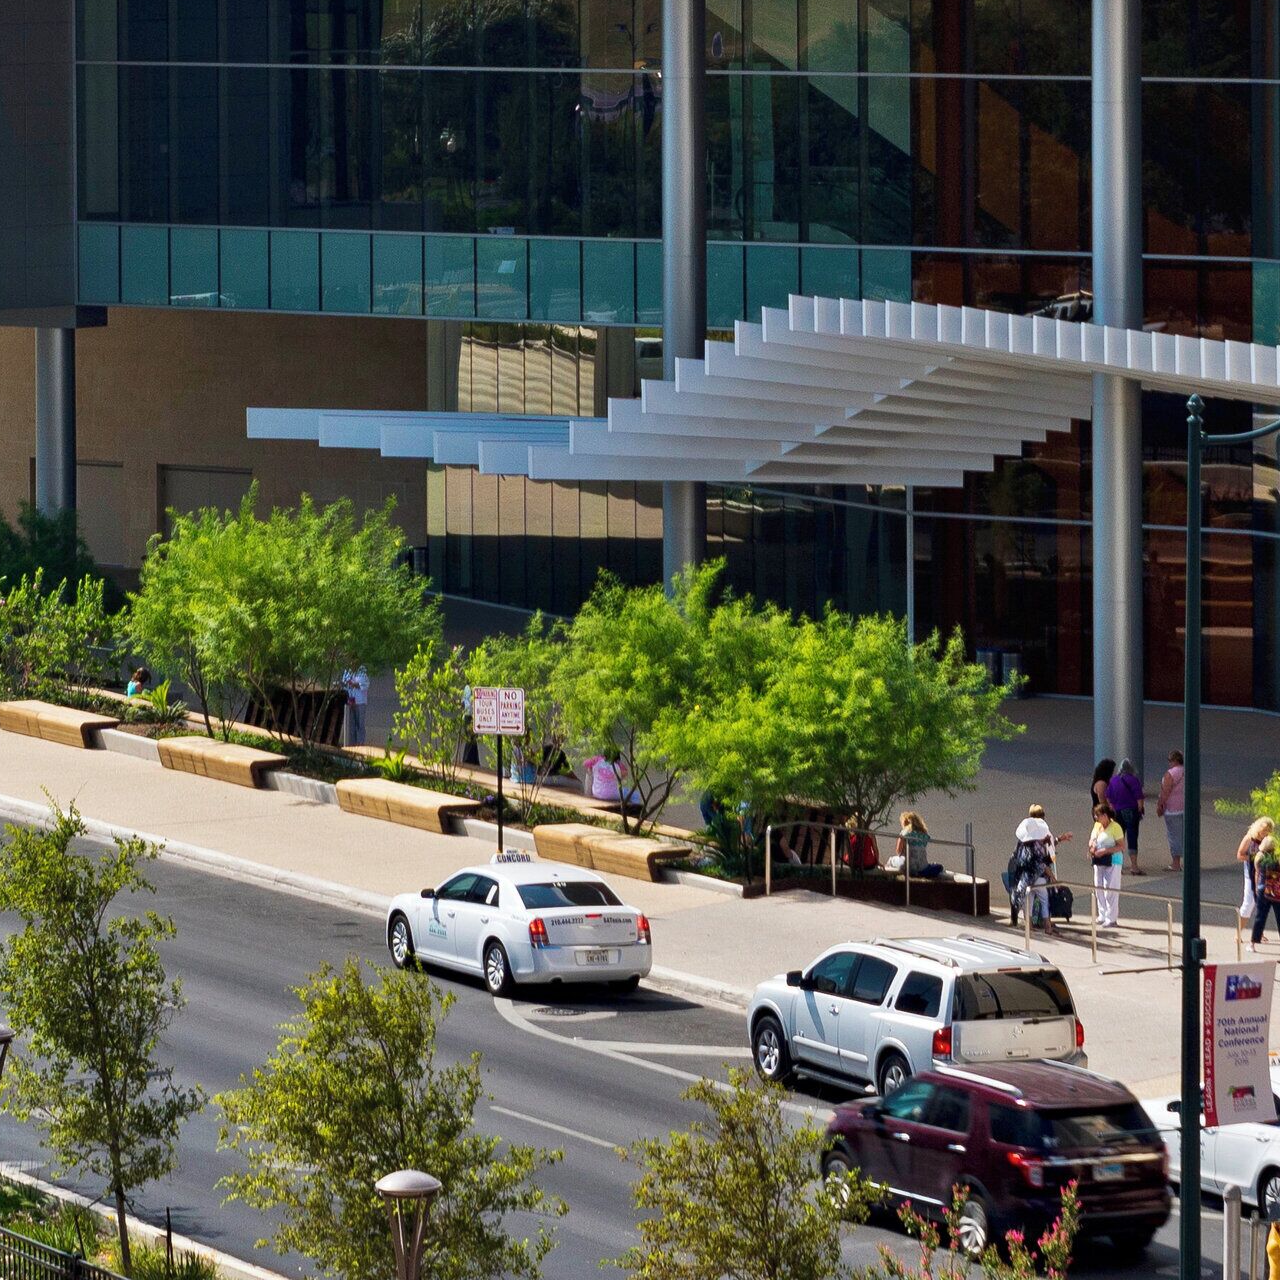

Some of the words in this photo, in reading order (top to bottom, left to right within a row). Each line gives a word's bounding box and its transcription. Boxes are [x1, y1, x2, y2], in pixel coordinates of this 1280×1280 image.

[504, 691, 517, 700] NO
[501, 701, 521, 710] PARKING
[1217, 1017, 1236, 1026] 70th
[1238, 1013, 1267, 1025] Annual
[1223, 1025, 1259, 1036] National
[1217, 1036, 1265, 1048] Conference
